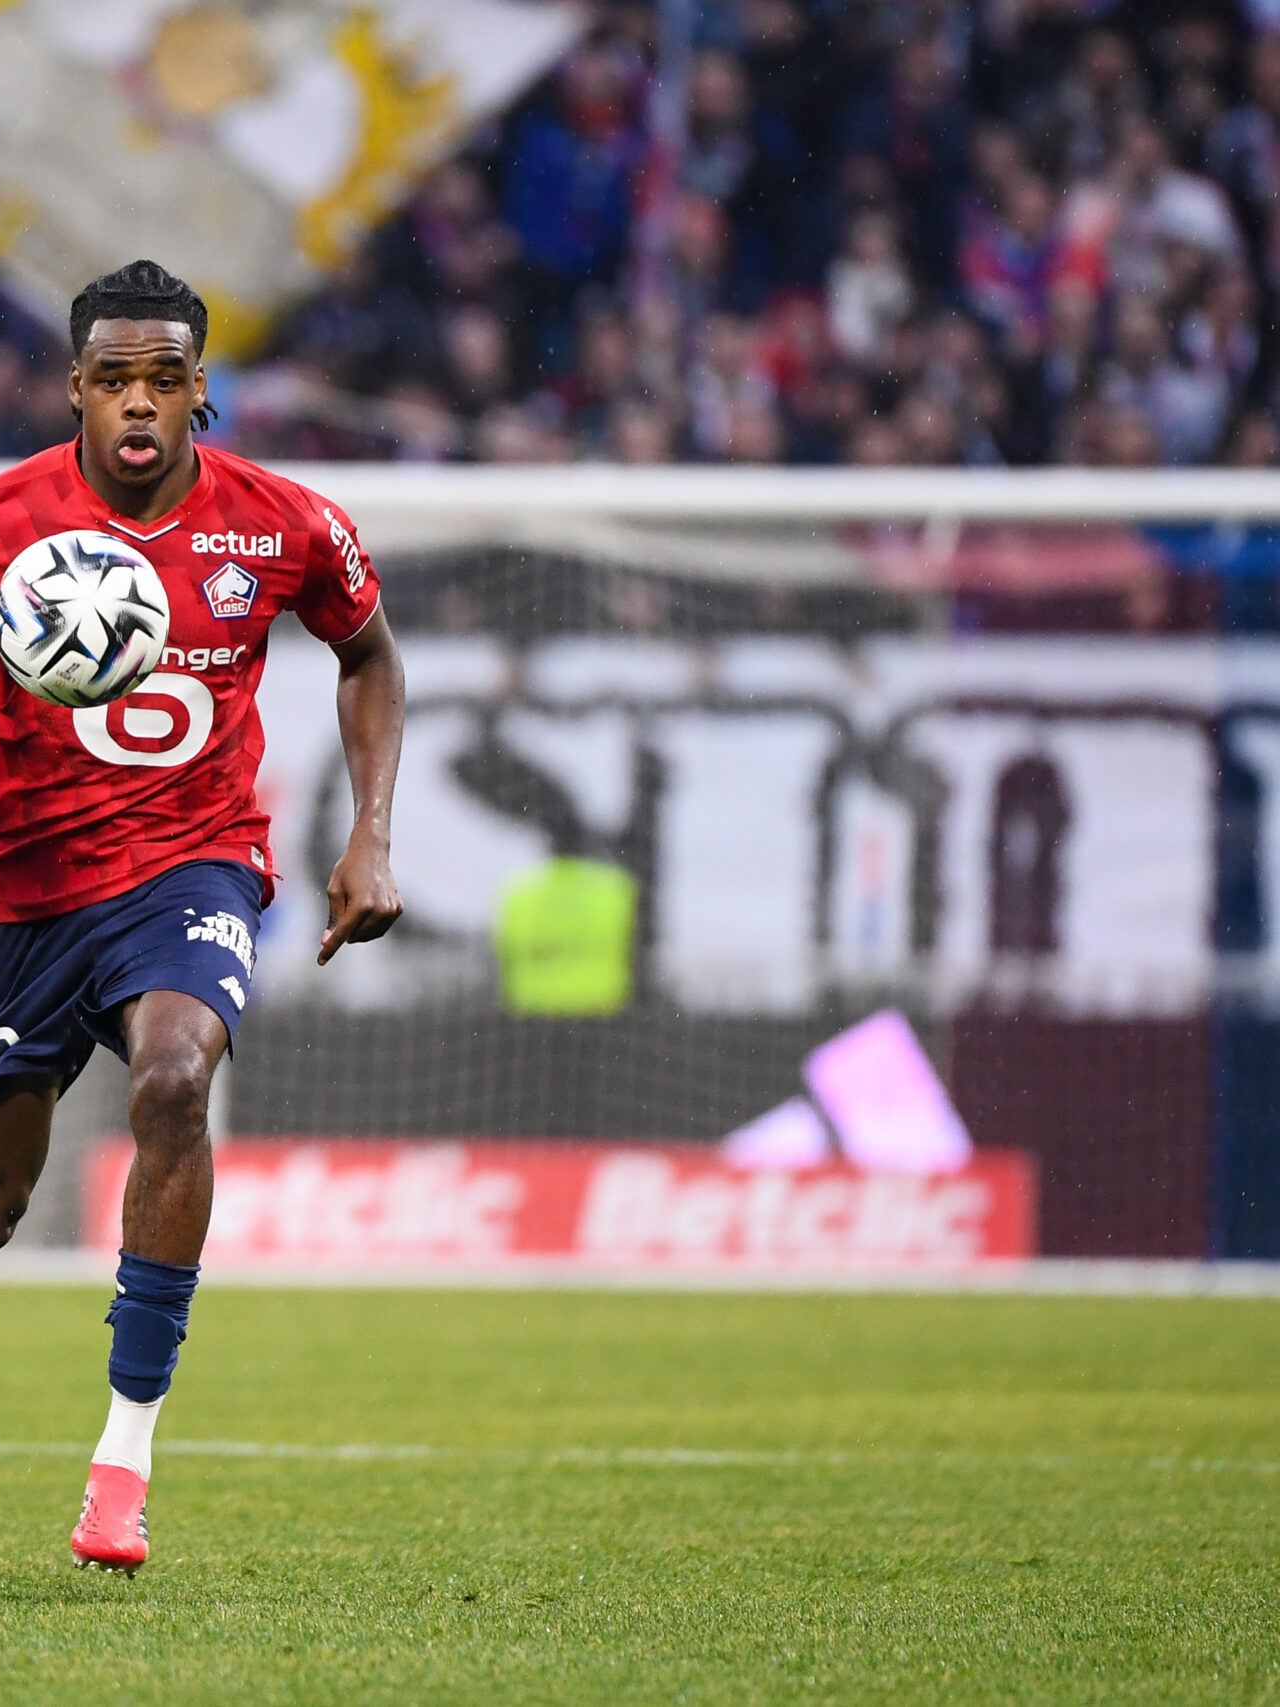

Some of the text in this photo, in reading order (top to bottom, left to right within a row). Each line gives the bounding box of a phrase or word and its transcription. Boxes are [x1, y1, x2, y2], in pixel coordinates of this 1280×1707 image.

[191, 530, 282, 557] actual
[217, 602, 246, 614] LOSC
[159, 645, 246, 671] nger
[118, 1150, 522, 1254] etclic
